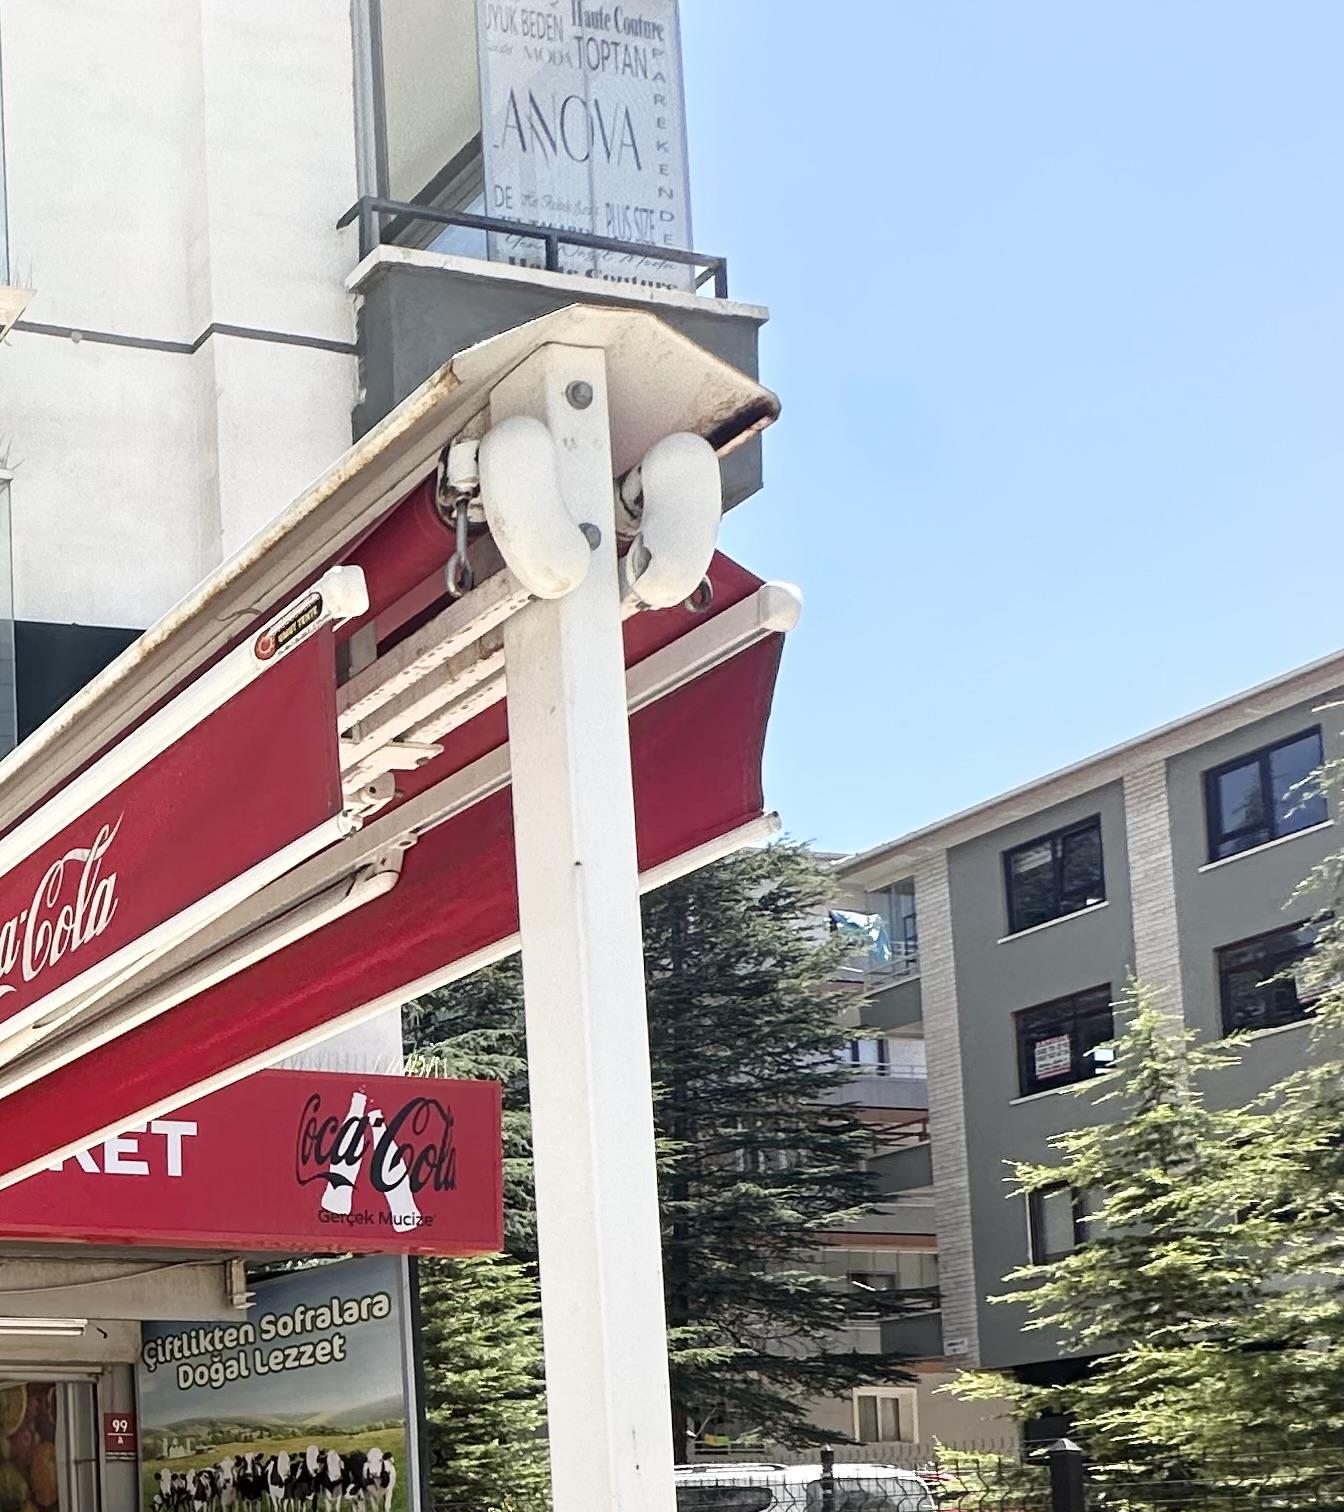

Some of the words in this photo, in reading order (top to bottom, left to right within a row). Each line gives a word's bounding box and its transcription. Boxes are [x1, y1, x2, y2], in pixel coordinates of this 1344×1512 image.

[520, 9, 564, 42] BEDEN
[614, 5, 664, 41] Couture
[573, 36, 648, 79] TOPTAN
[497, 87, 643, 172] ANOVA
[296, 1092, 457, 1194] Coca-Cola
[319, 1209, 375, 1228] Gerçek
[378, 1211, 433, 1228] Mucize
[142, 1321, 255, 1370] Çiftlikten
[260, 1291, 391, 1341] Sofralara
[177, 1353, 250, 1389] Doğal
[255, 1332, 346, 1375] Lezzet
[112, 1419, 128, 1433] 99
